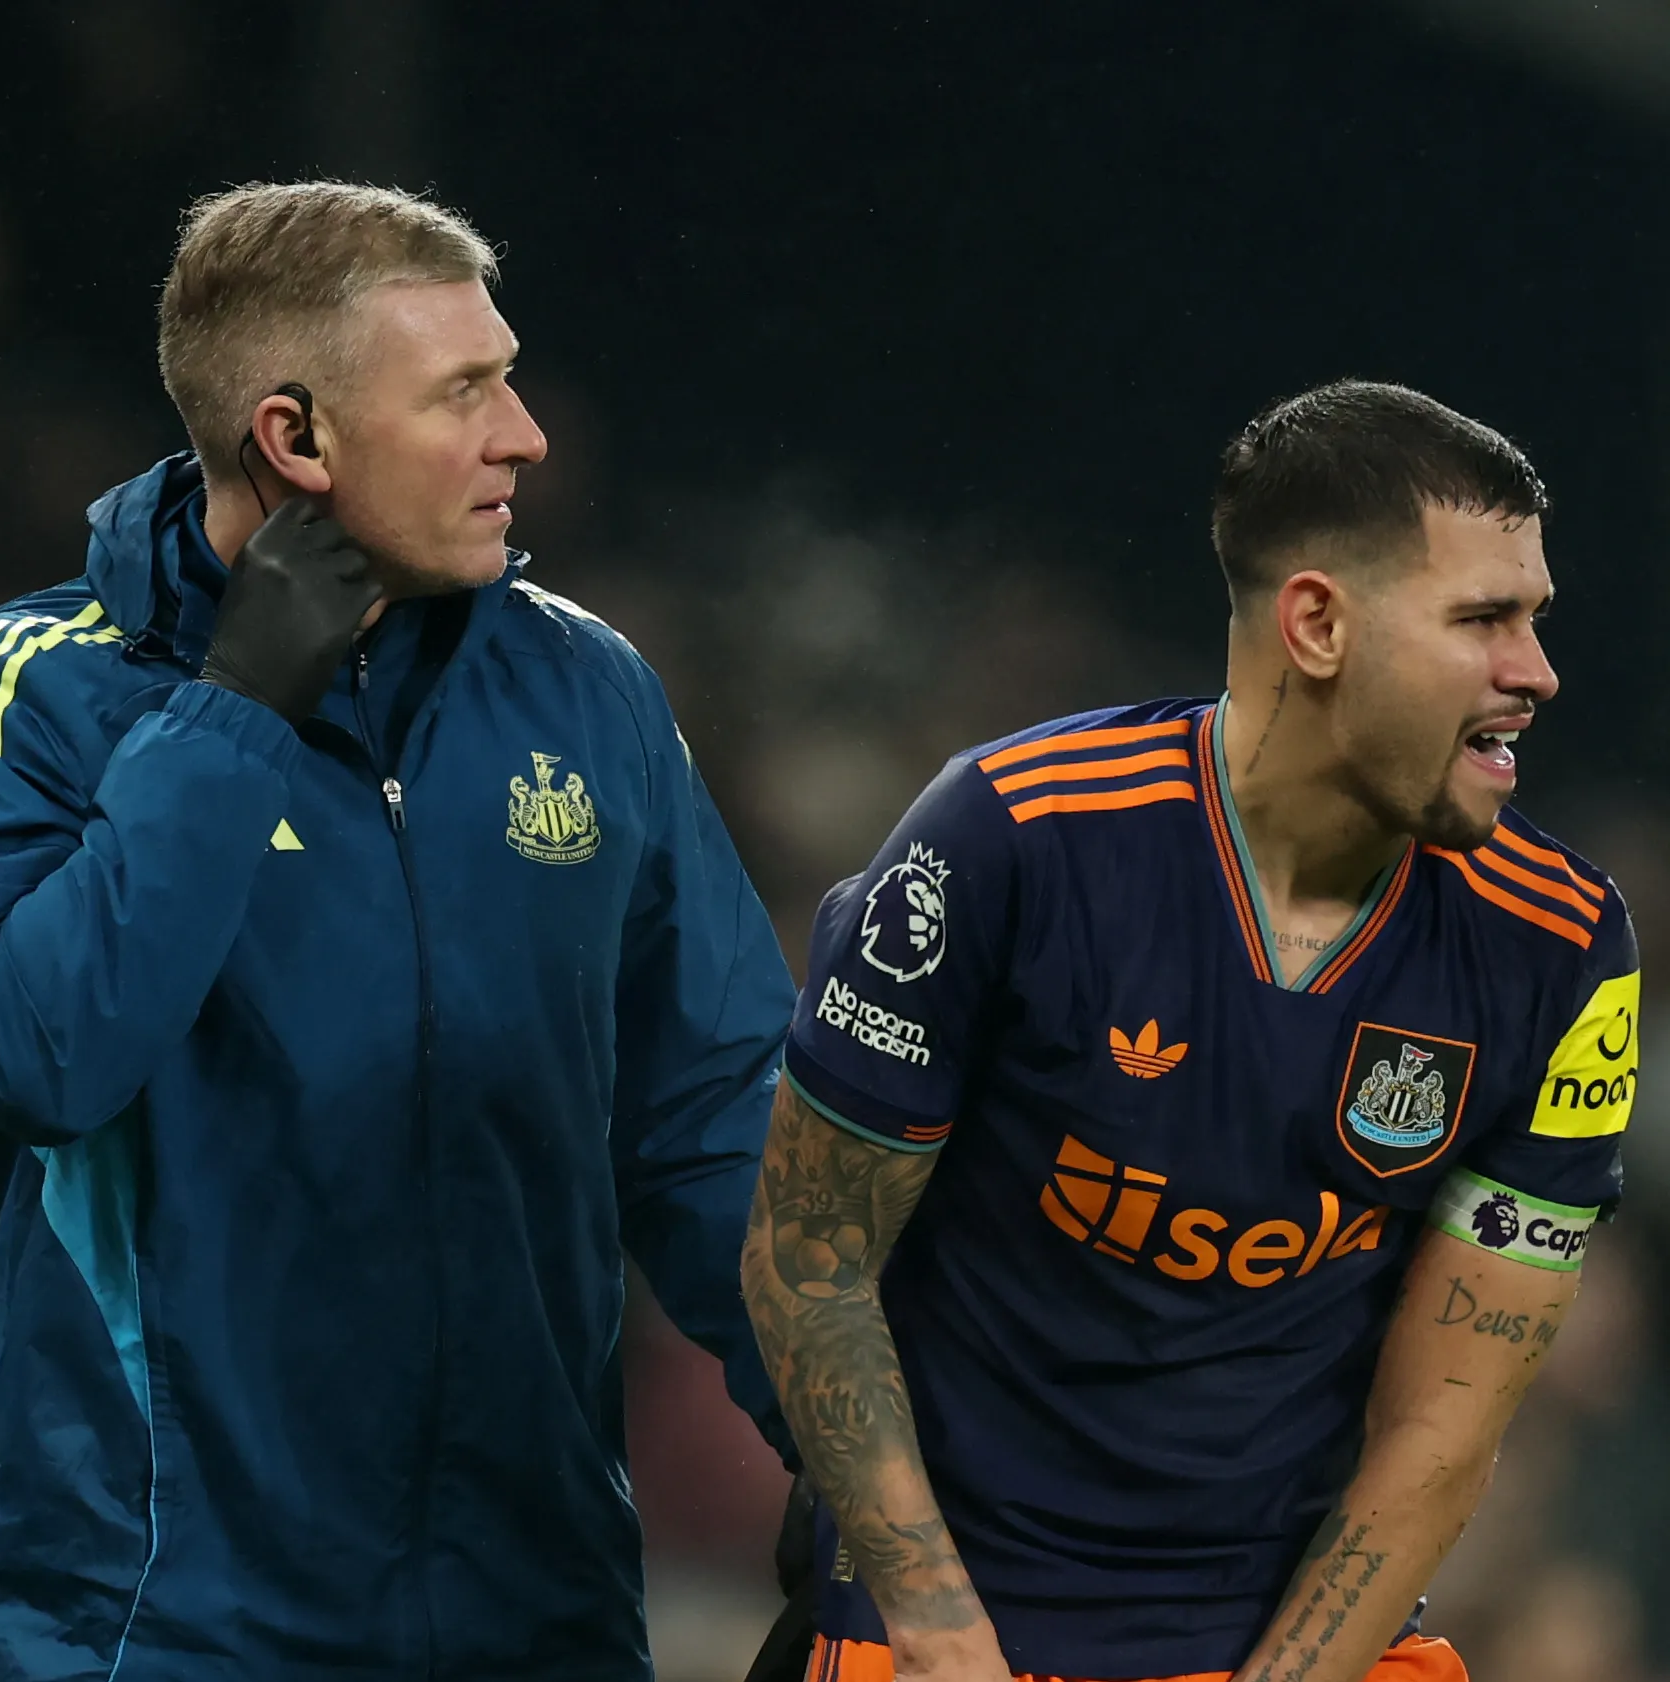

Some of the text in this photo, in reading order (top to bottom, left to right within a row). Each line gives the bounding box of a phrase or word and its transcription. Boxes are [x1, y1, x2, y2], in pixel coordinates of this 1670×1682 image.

[523, 846, 593, 860] NEWCASTLE UNITED
[824, 976, 925, 1043] No room
[851, 1019, 930, 1066] racism
[1153, 1191, 1392, 1288] sela
